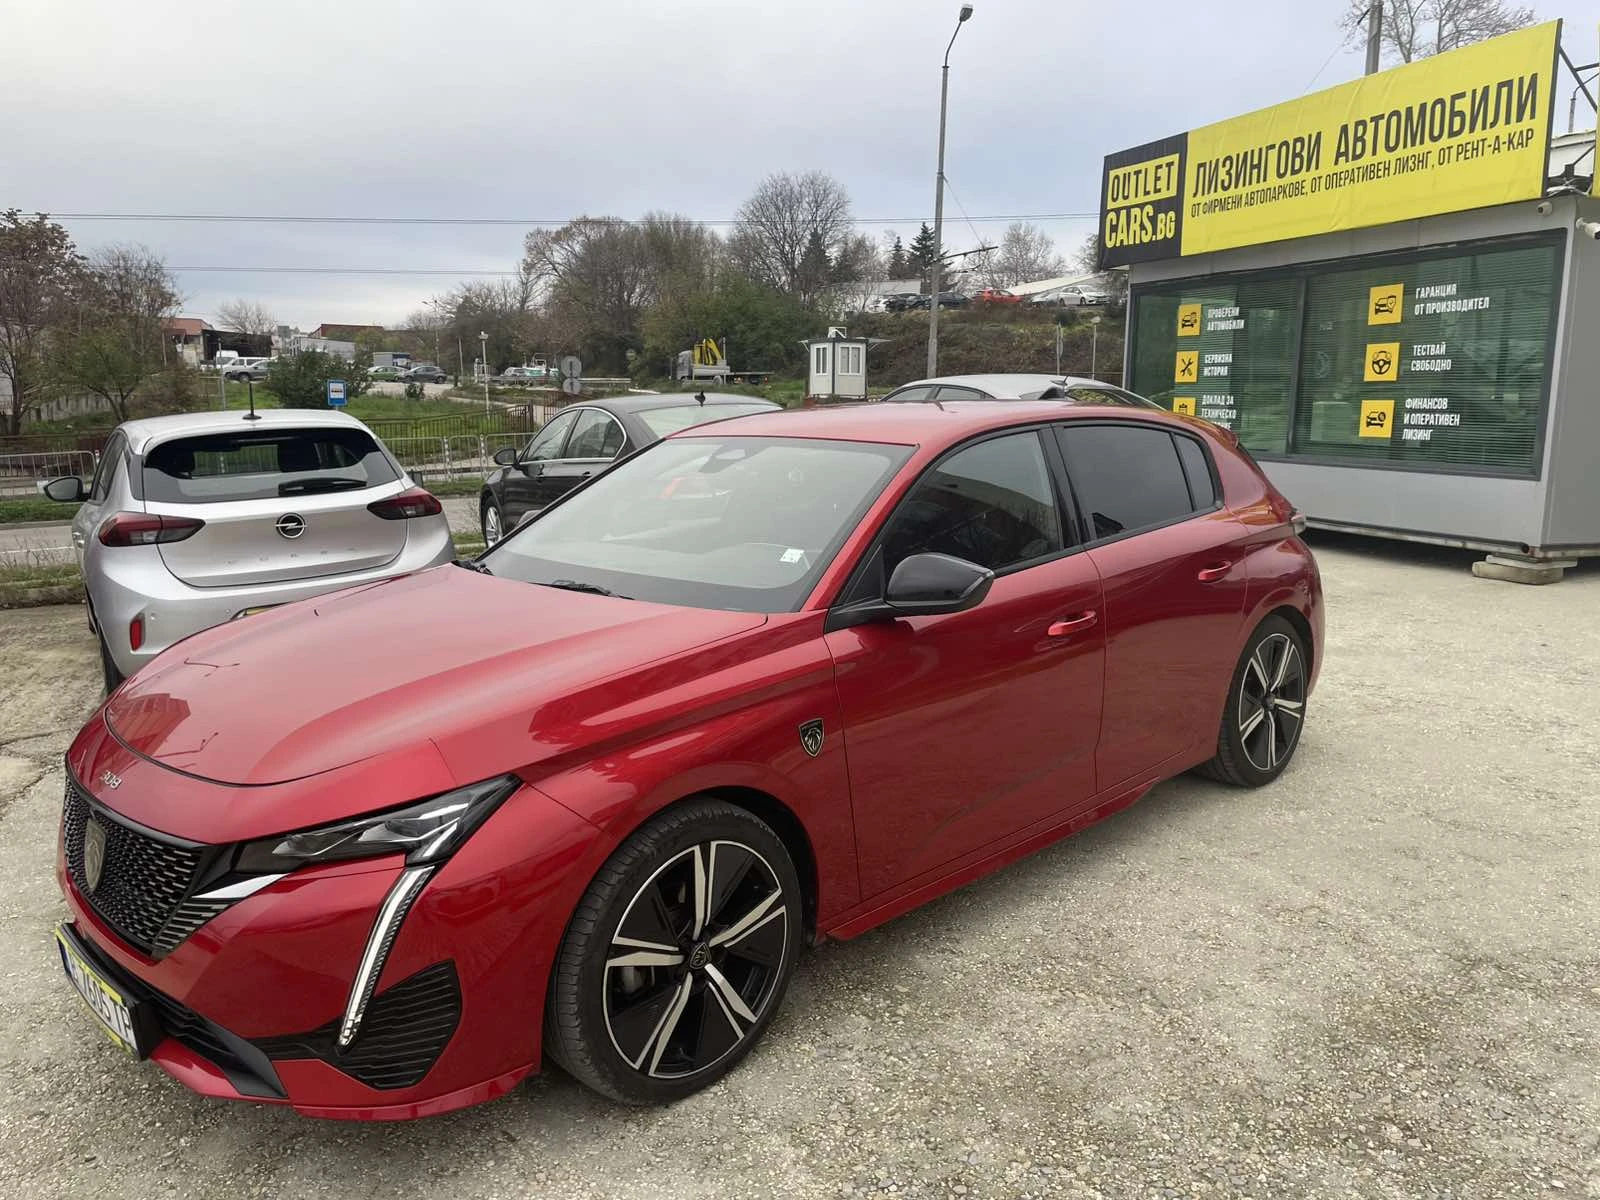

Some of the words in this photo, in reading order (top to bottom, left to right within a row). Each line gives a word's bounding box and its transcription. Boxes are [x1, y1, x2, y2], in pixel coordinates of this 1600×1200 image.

[1192, 131, 1322, 198] ЛИЗИНГОВИ
[1333, 72, 1539, 166] АВТОМОБИЛИ
[1191, 202, 1201, 218] ОТ
[1202, 194, 1243, 215] ФИРМЕНИ
[1243, 179, 1309, 208] АВТОПАРКОВЕ,
[1310, 176, 1323, 193] ОТ
[1324, 159, 1390, 193] ОПЕРАТИВЕН
[1438, 145, 1453, 166] ОТ
[1455, 128, 1535, 162] РЕНТ-А-КАР
[1111, 161, 1175, 203] OUTLET
[1105, 204, 1176, 249] CARS.BG
[1415, 284, 1457, 299] ГАРАНЦИЯ
[1414, 304, 1424, 316] ОТ
[1425, 297, 1490, 315] ПРОИЗВОДИТЕЛ
[1413, 341, 1446, 356] ТЕСТВАЙ
[1411, 359, 1452, 372] СВОБОДНО
[1405, 397, 1448, 409] ФИНАНСОВ
[1404, 413, 1410, 425] И
[1410, 413, 1460, 427] ОПЕРАТИВЕН
[1402, 428, 1433, 440] ЛИЗИНГ
